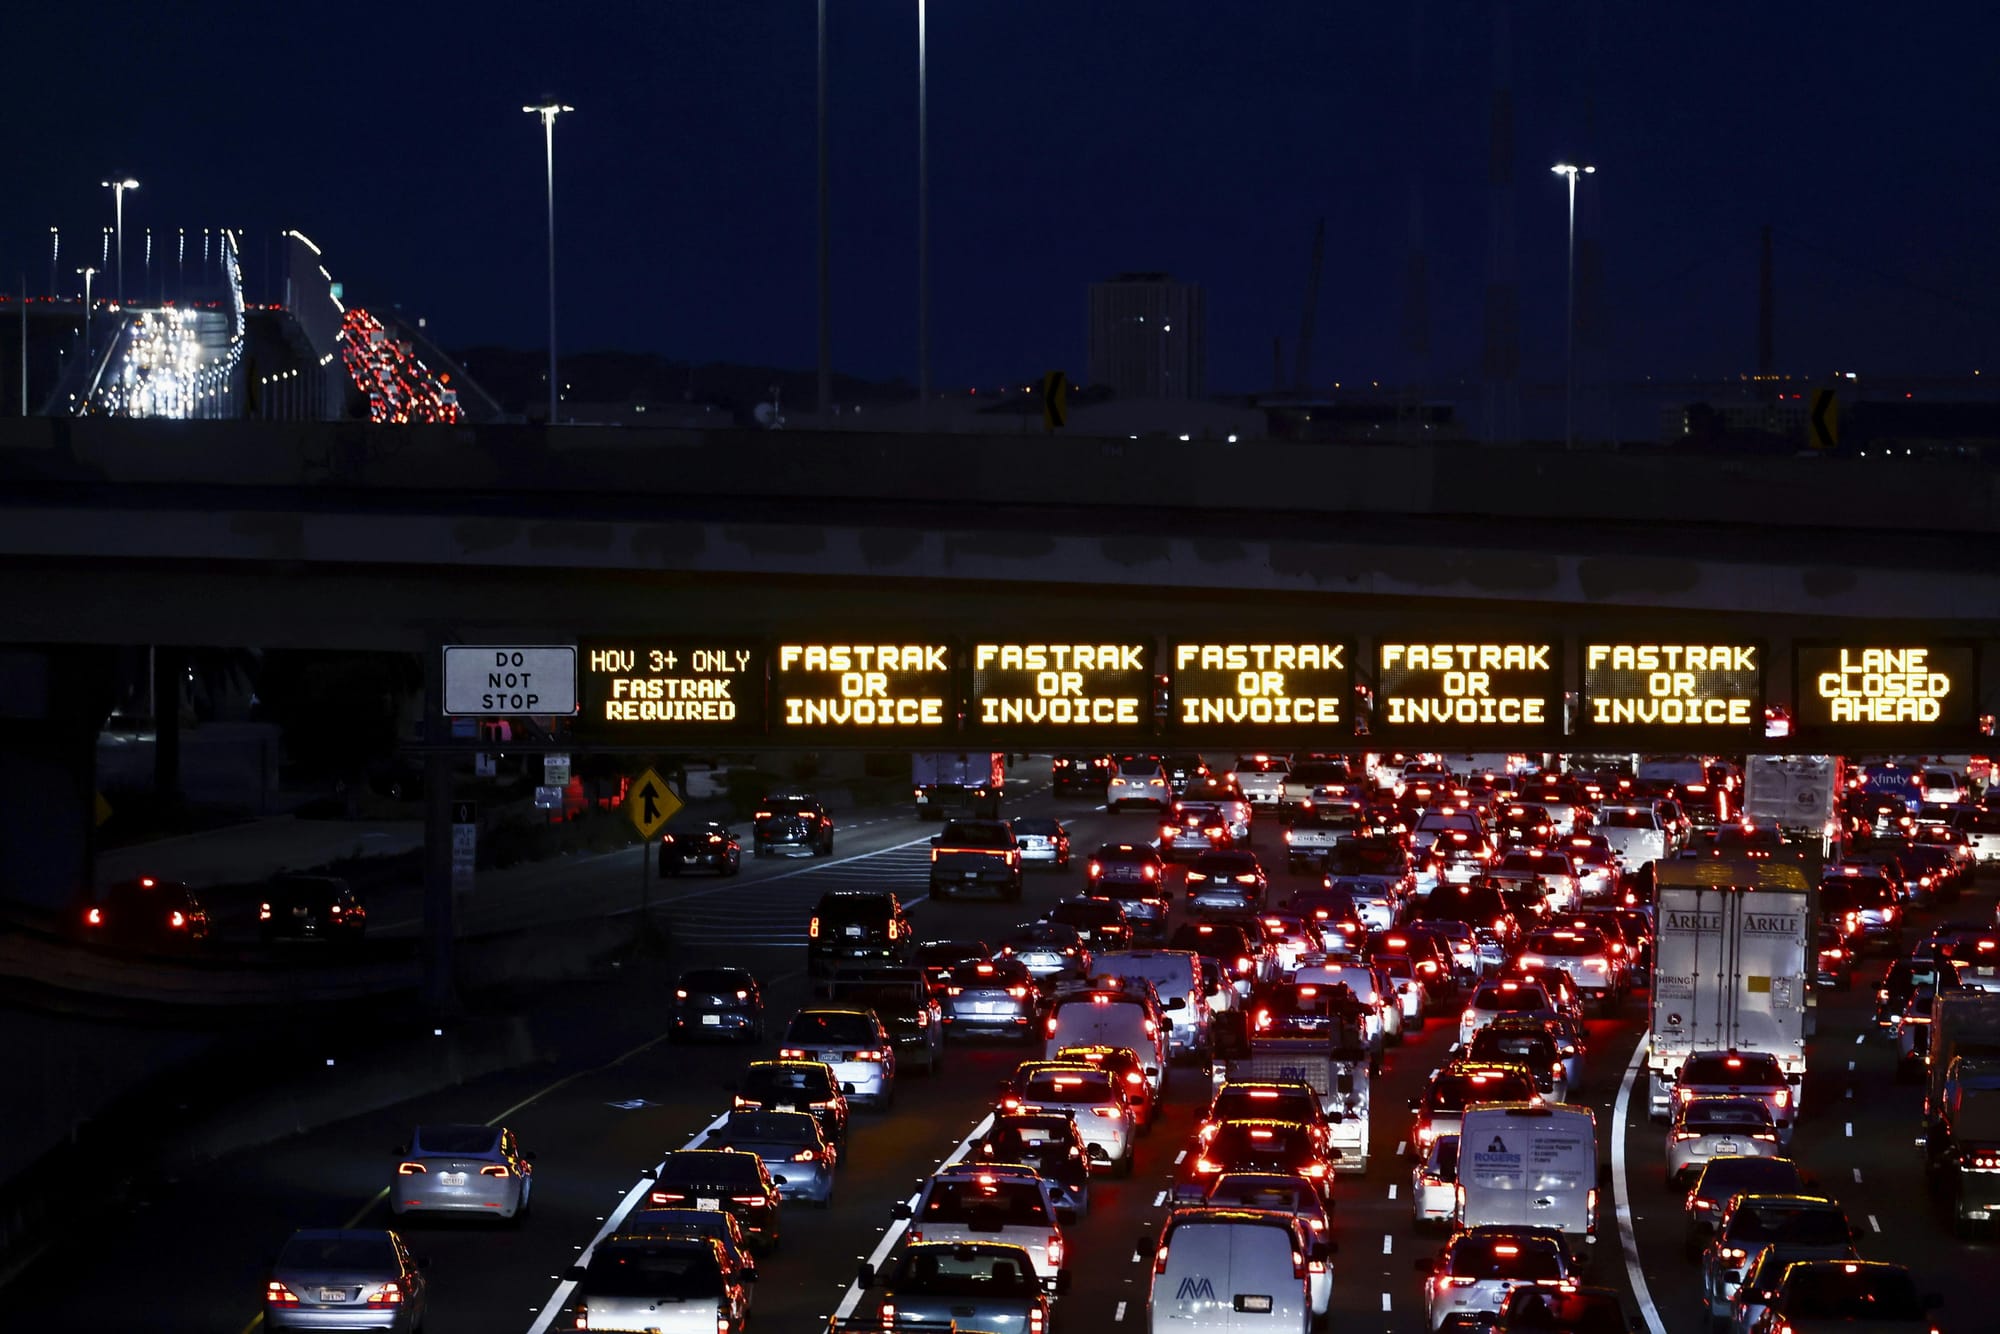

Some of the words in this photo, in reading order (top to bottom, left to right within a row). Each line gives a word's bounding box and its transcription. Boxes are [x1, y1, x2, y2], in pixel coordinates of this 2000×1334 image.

[495, 651, 524, 668] DO
[591, 649, 635, 672] HOV
[650, 650, 678, 672] 3+
[693, 650, 750, 673] ONLY
[780, 645, 948, 671] FASTRAK
[976, 645, 1144, 671] FASTRAK
[1177, 644, 1345, 670] FASTRAK
[1382, 644, 1550, 670] FASTRAK
[1588, 645, 1756, 671] FASTRAK
[1840, 648, 1929, 673] LANE
[488, 672, 532, 689] NOT
[613, 678, 731, 699] FASTRAK
[840, 672, 889, 697] OR
[1036, 672, 1085, 697] OR
[1237, 671, 1286, 696] OR
[1442, 671, 1491, 696] OR
[1648, 672, 1697, 697] OR
[1818, 673, 1950, 698] CLOSED
[481, 693, 540, 710] STOP
[606, 700, 736, 721] REQUIRED
[785, 698, 943, 724] INVOICE
[981, 698, 1139, 724] INVOICE
[1182, 697, 1340, 723] INVOICE
[1387, 697, 1545, 723] INVOICE
[1593, 698, 1751, 724] INVOICE
[1831, 697, 1941, 722] AHEAD
[1870, 773, 1909, 787] xfinity
[1665, 912, 1721, 930] ARKLE
[1744, 914, 1798, 932] ARKLE
[1658, 975, 1694, 985] HIRING!
[1474, 1152, 1521, 1163] ROGERS
